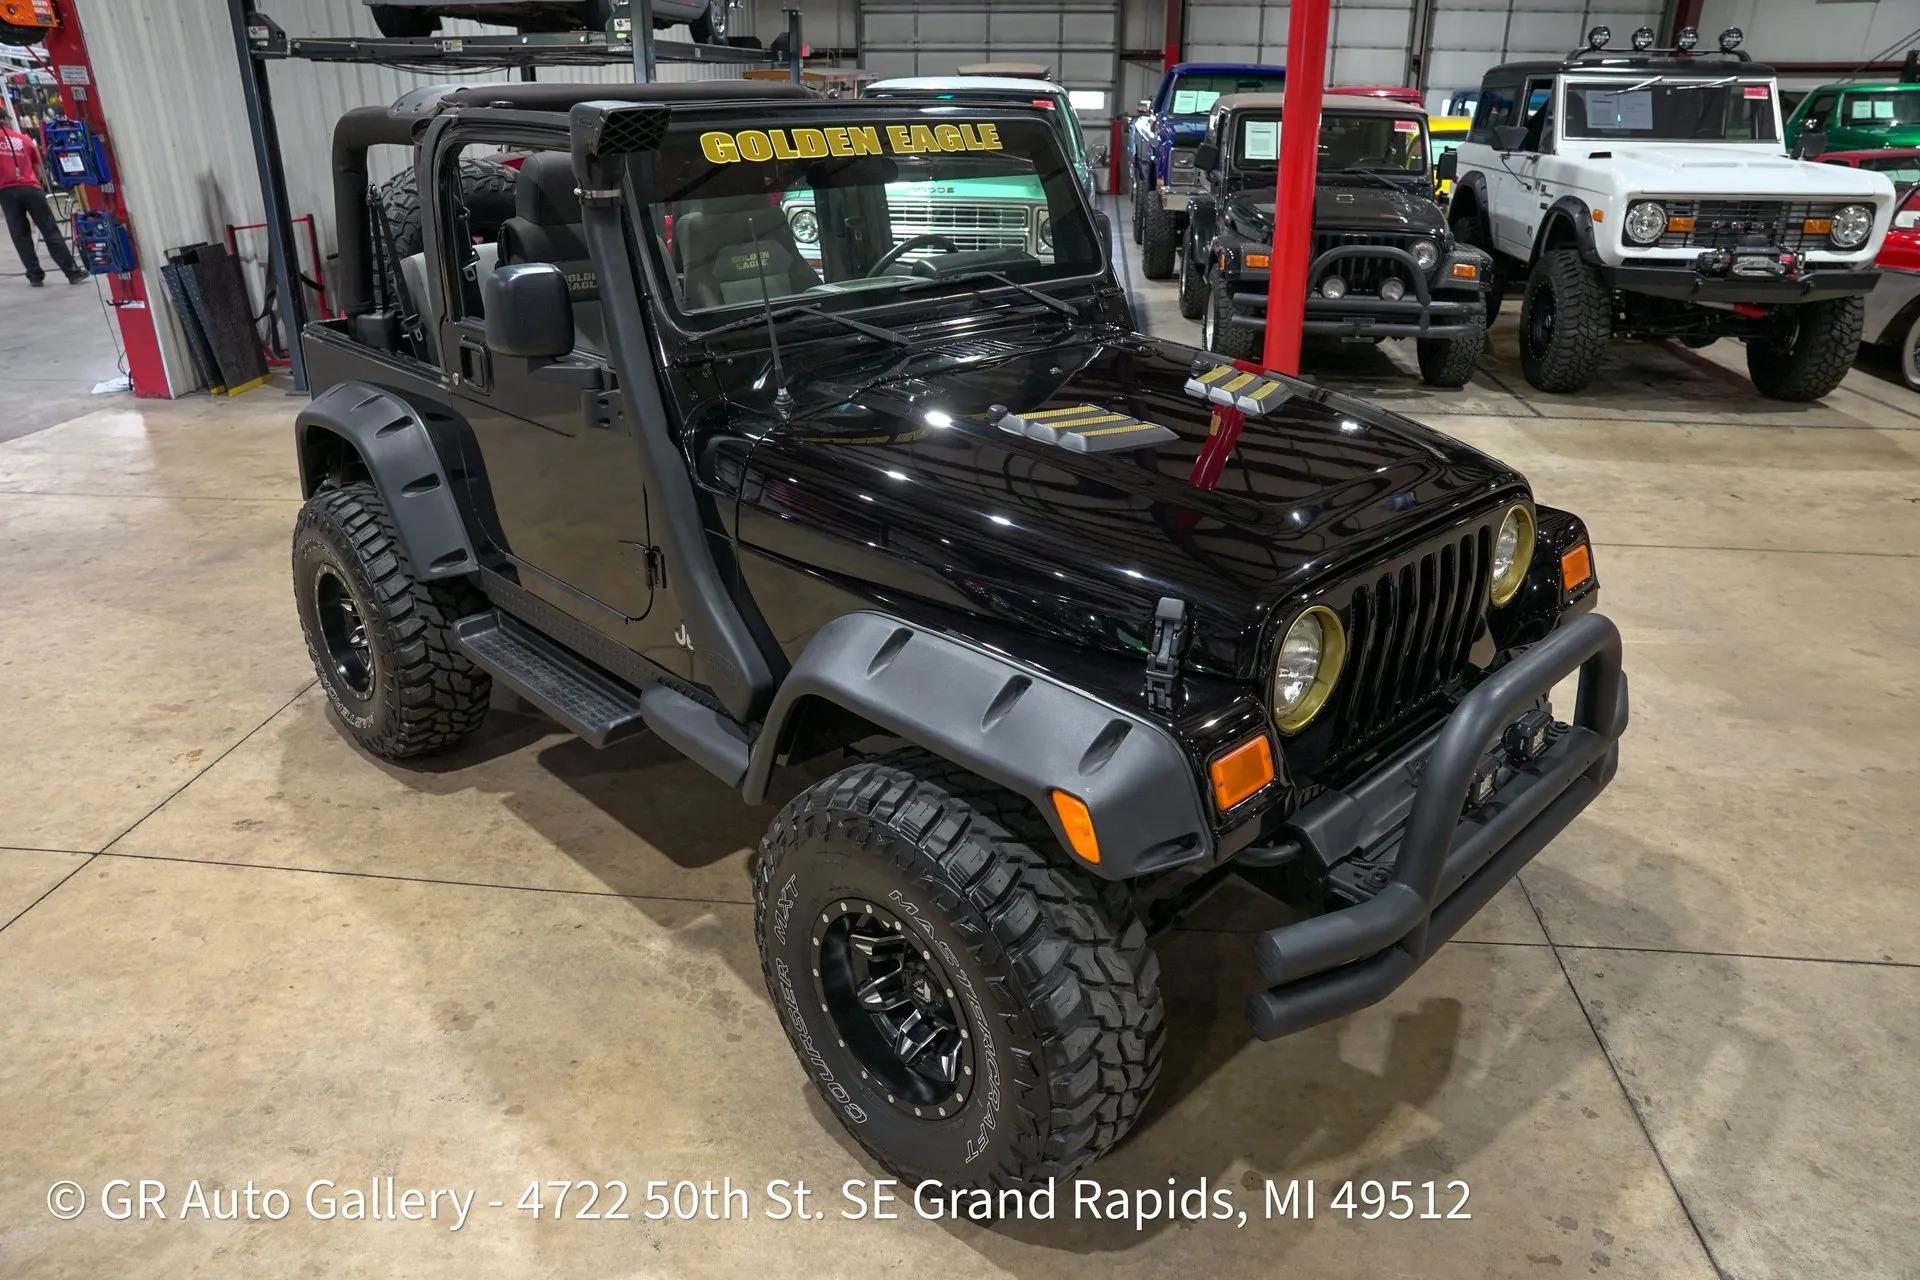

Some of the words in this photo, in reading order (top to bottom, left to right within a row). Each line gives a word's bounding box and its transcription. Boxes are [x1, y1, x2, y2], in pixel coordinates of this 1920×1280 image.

[700, 127, 883, 164] GOLDEN
[886, 123, 1003, 154] EAGLE
[773, 874, 799, 945] MXT
[776, 957, 868, 1124] COURSER
[888, 889, 1001, 1164] MASTERCRAFT
